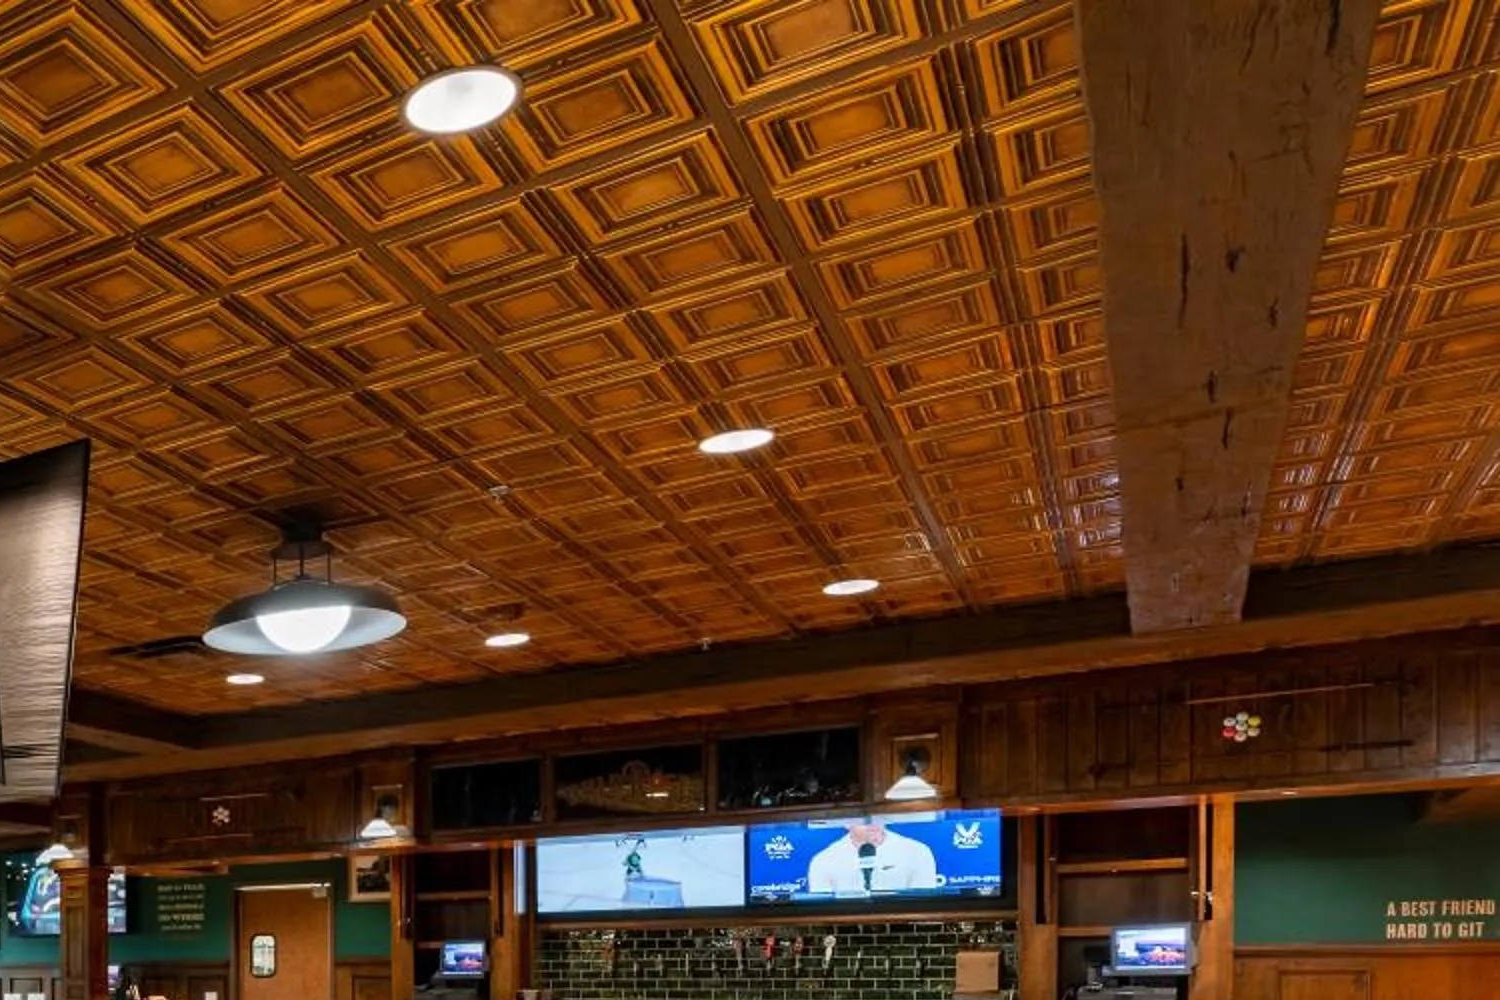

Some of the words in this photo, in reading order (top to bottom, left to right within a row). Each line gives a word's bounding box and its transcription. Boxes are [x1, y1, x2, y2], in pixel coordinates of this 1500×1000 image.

[1387, 901, 1396, 917] A
[1401, 901, 1435, 916] BEST
[1441, 899, 1496, 916] FRIEND
[1386, 923, 1427, 939] HARD
[1432, 922, 1452, 938] TO
[1458, 921, 1485, 937] GIT
